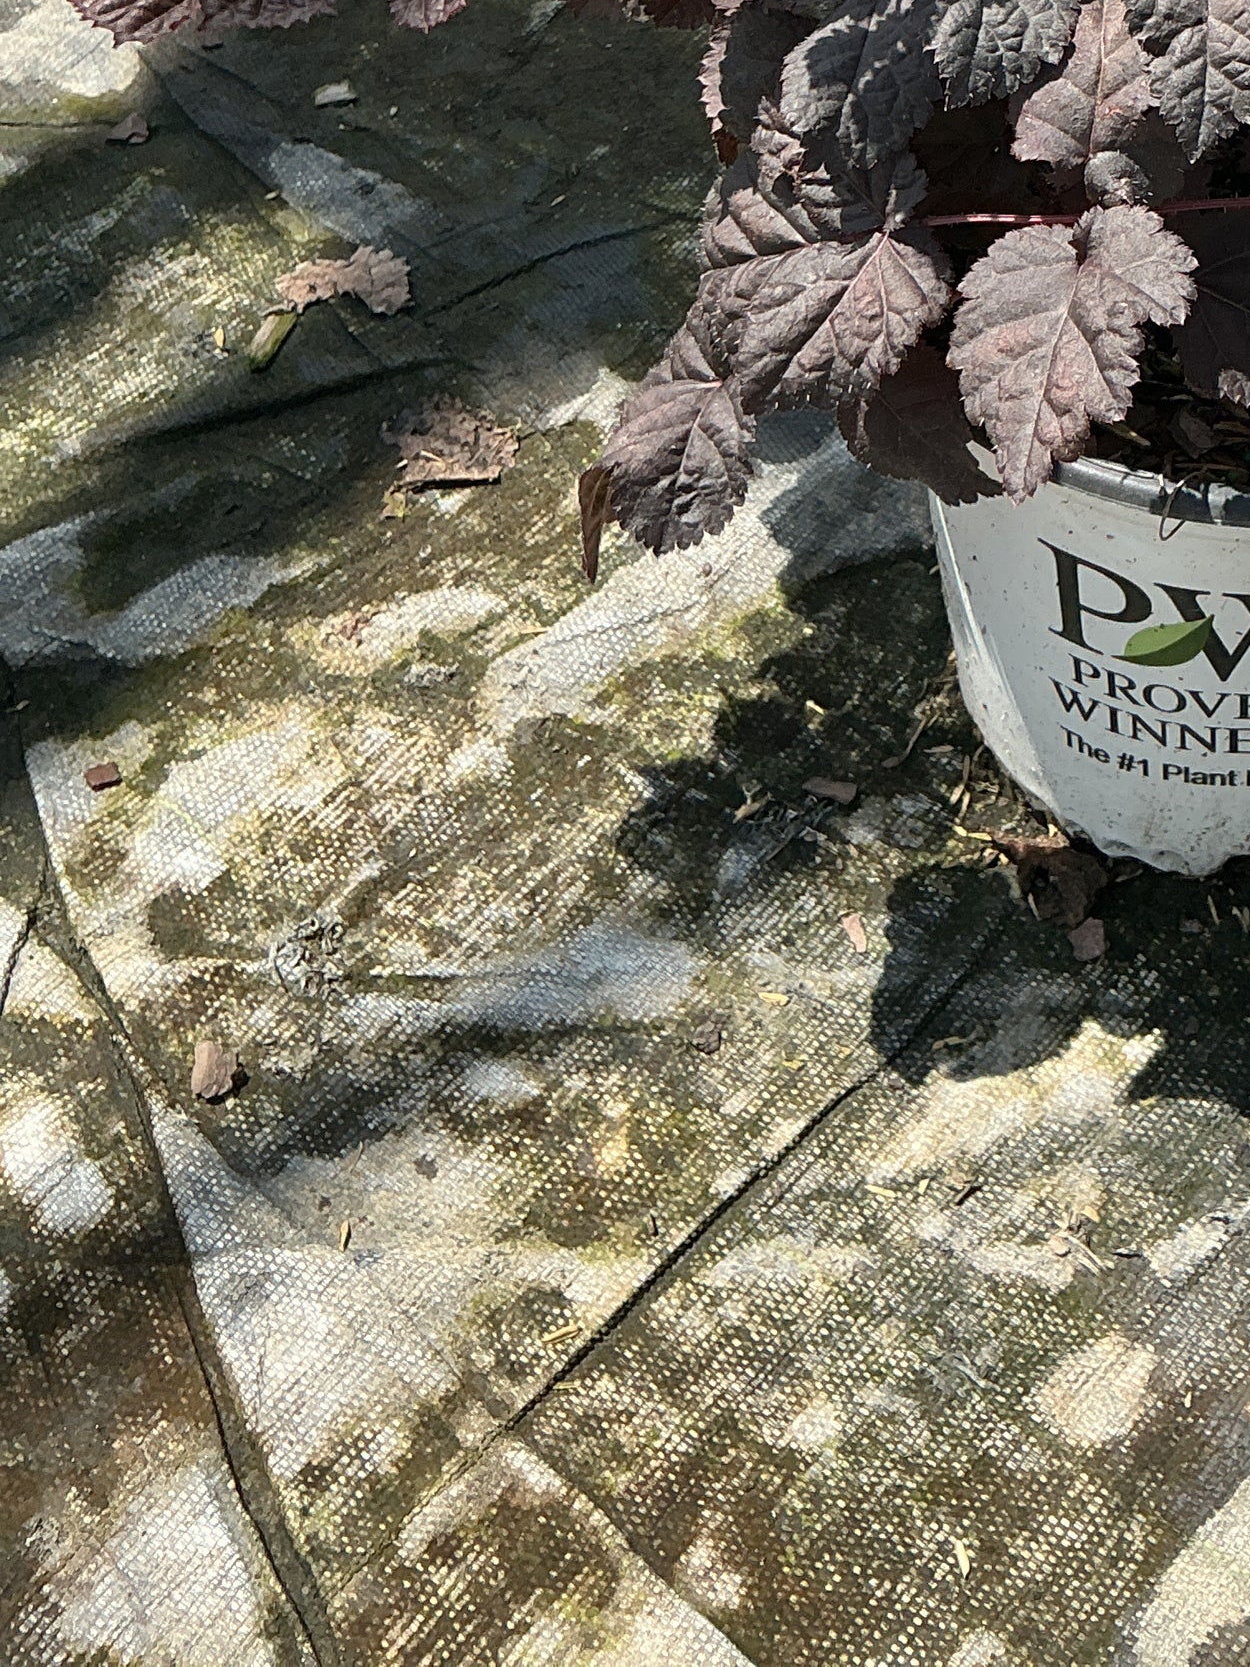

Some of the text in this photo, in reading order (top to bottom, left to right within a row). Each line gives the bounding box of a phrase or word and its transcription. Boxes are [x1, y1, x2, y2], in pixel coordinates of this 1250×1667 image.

[1060, 724, 1111, 764] The
[1117, 752, 1150, 777] #1
[1162, 762, 1239, 787] Plant
